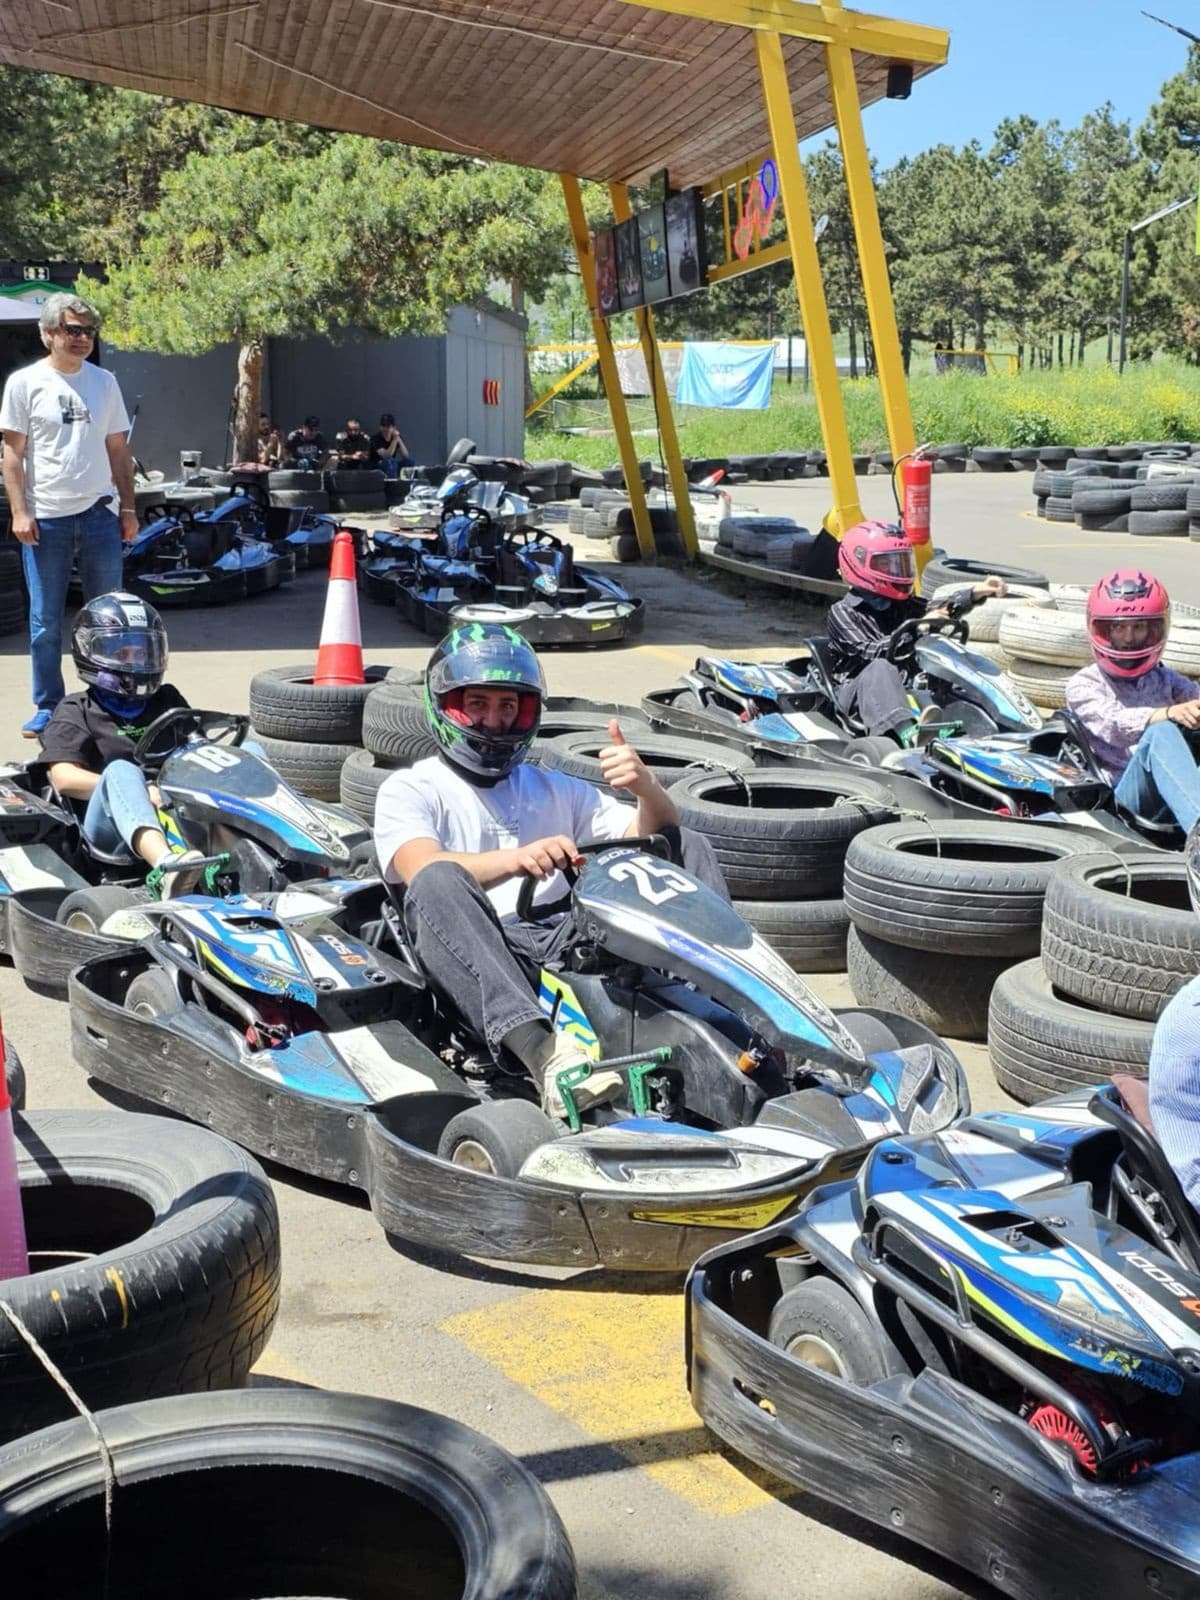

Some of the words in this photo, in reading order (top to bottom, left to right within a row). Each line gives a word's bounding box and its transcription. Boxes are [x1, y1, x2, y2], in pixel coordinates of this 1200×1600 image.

[181, 745, 242, 774] 18
[608, 856, 698, 906] 25
[1117, 1251, 1196, 1297] SODI
